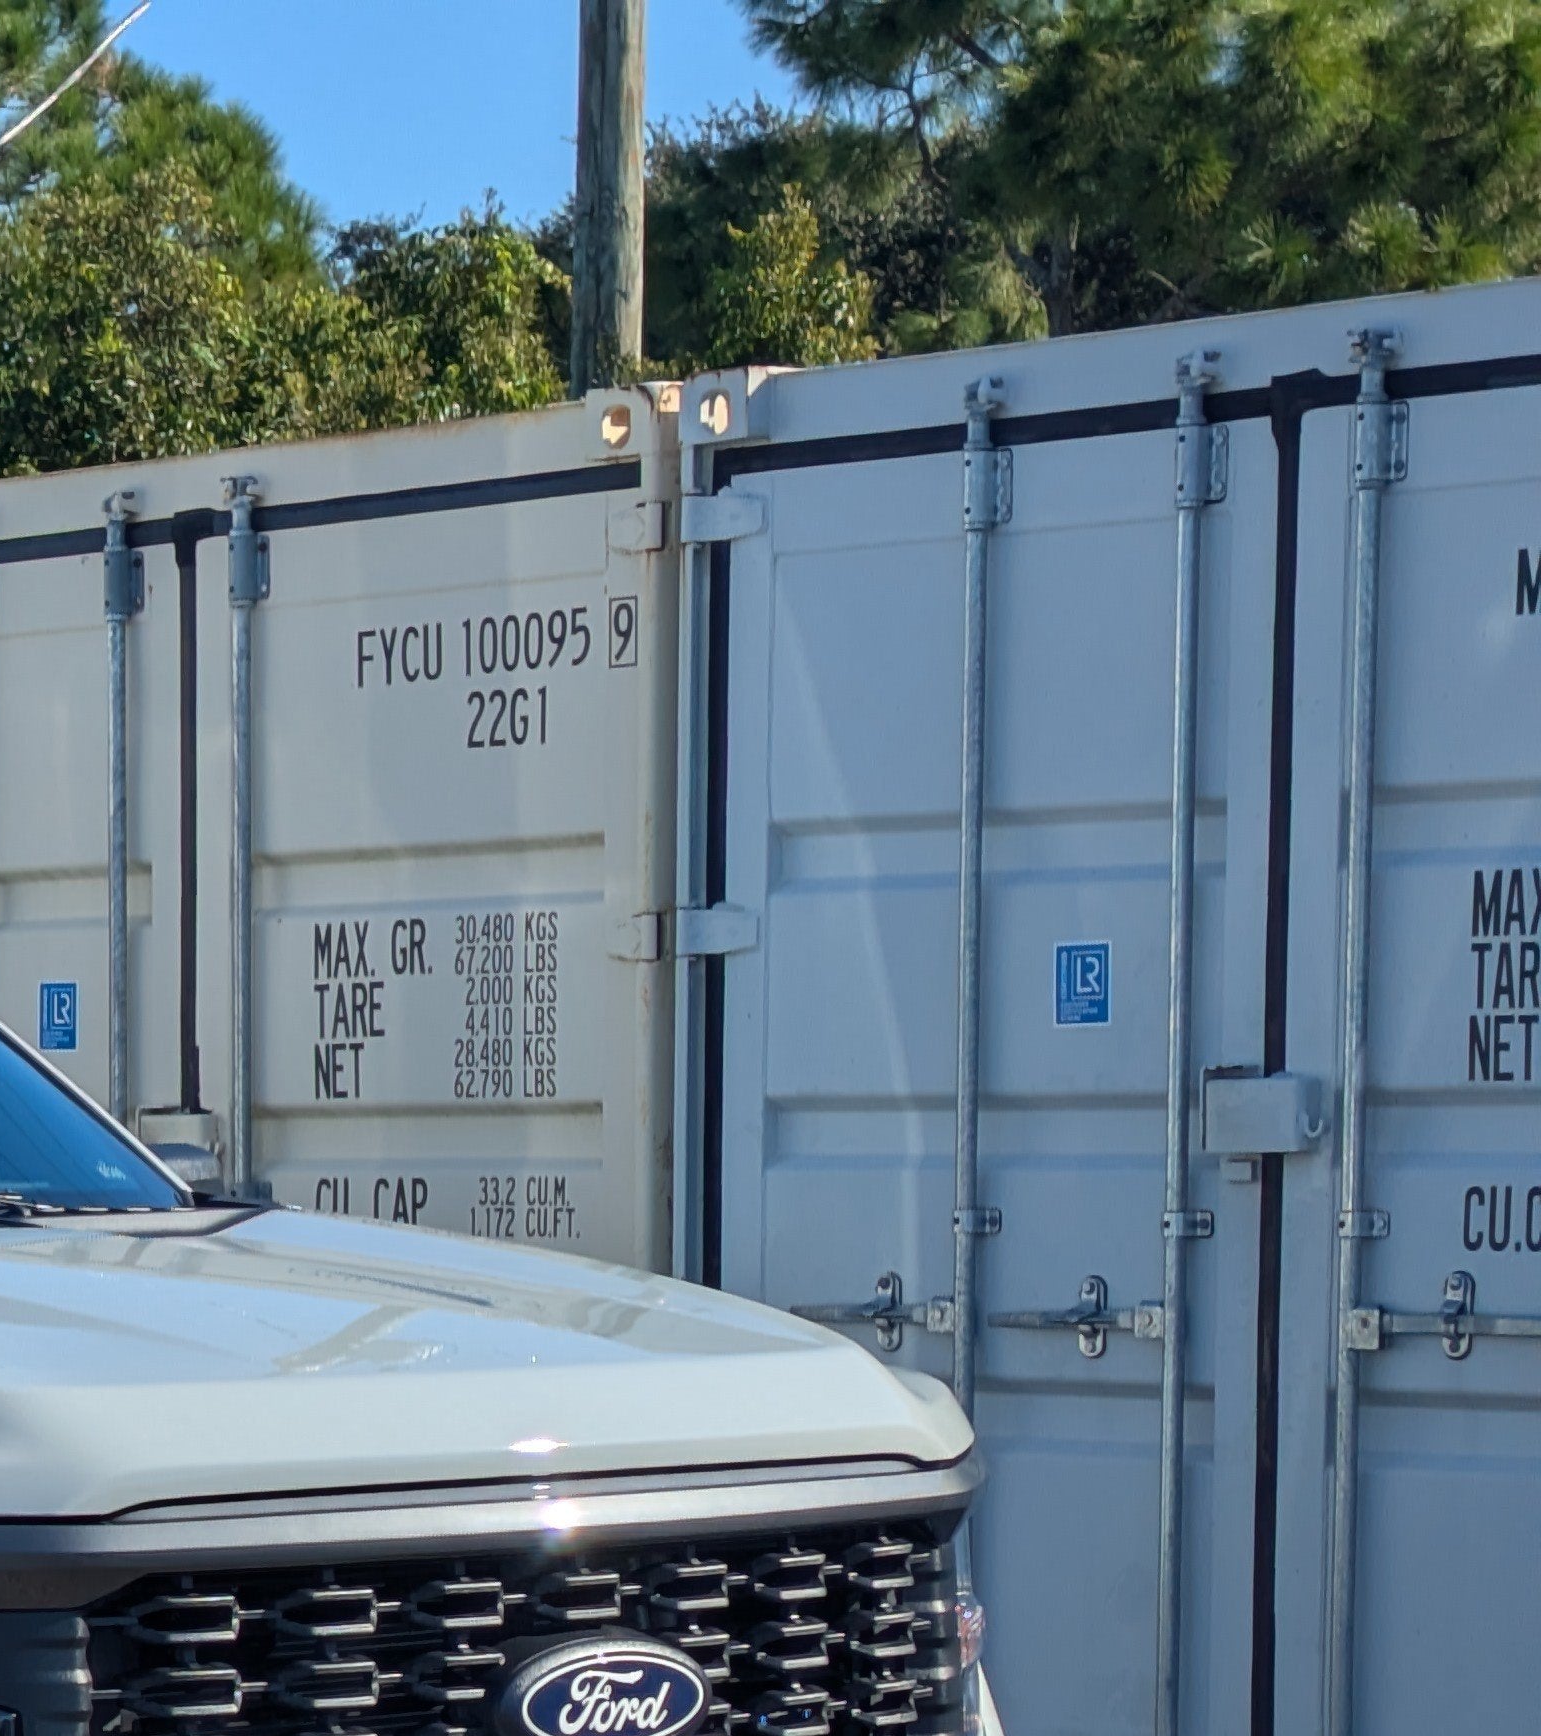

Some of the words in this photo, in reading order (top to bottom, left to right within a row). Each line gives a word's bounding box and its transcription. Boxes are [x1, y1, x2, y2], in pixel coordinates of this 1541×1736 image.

[357, 622, 443, 688] FYCU
[462, 606, 591, 676] 100095
[467, 686, 548, 748] 22G1
[314, 920, 376, 979] MAX.
[391, 918, 433, 975] GR.
[525, 911, 558, 941] KGS
[524, 943, 558, 973] LBS
[314, 981, 385, 1038] TARE
[524, 974, 557, 1004] KGS
[523, 1006, 557, 1035] LBS
[1468, 1014, 1540, 1081] NET
[314, 1042, 364, 1100] NET
[523, 1036, 557, 1066] KGS
[523, 1068, 557, 1098] LBS
[559, 1669, 671, 1735] Ford
